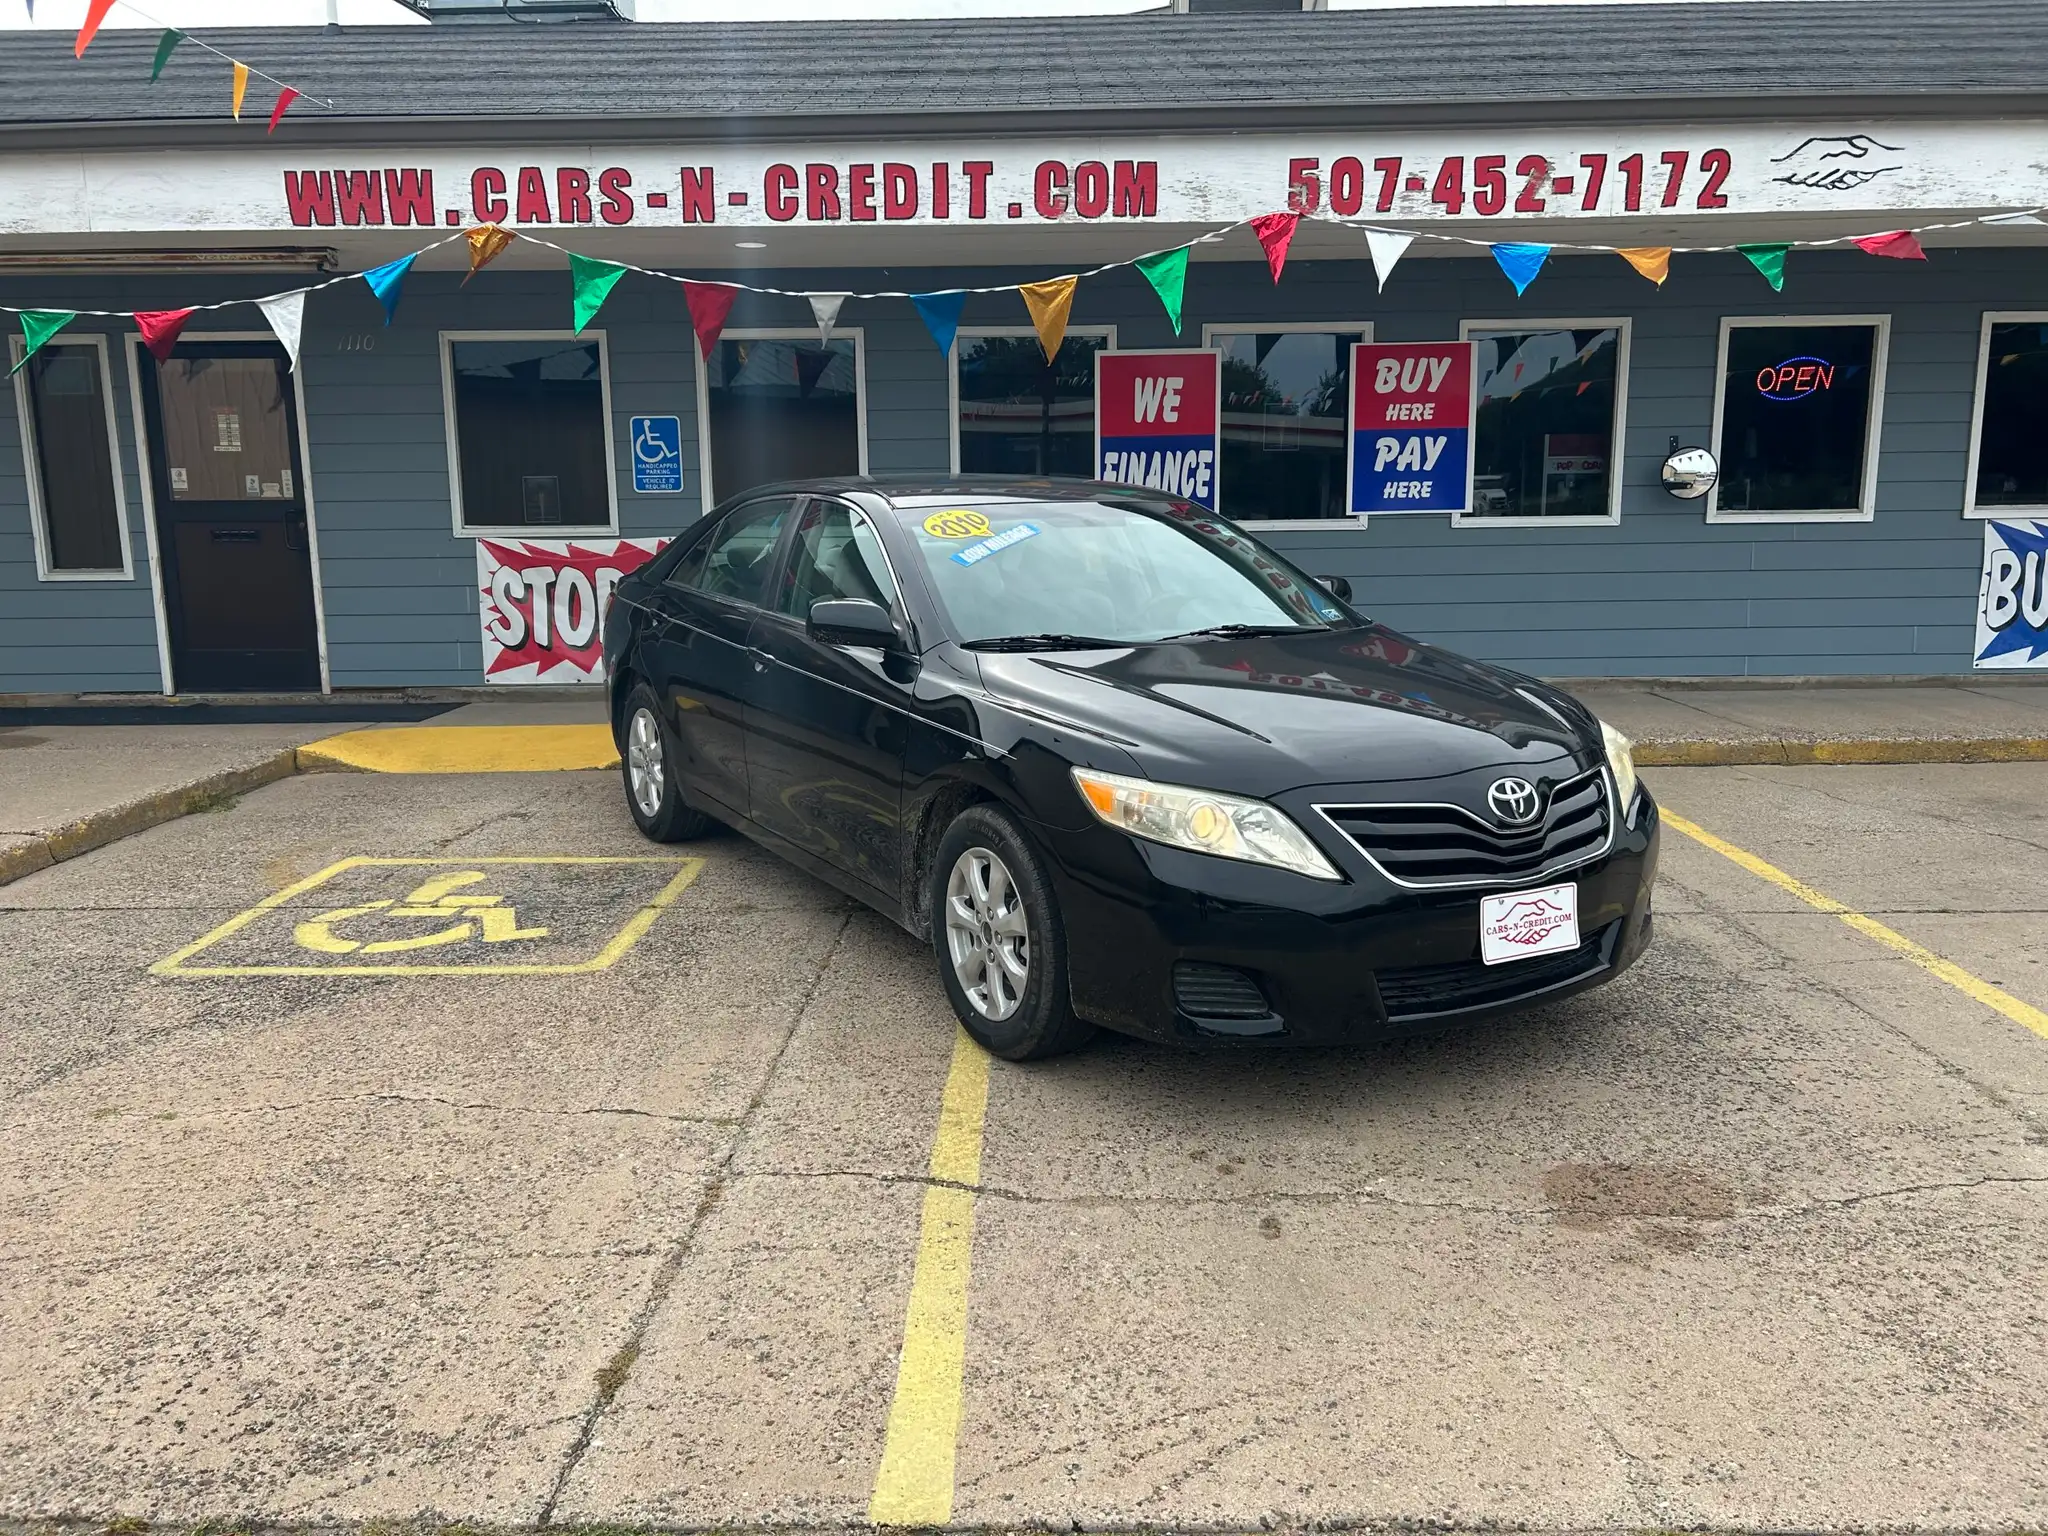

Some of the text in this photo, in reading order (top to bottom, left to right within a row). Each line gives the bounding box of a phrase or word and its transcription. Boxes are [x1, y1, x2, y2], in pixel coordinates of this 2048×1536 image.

[1288, 148, 1731, 217] 507-452-7172
[1374, 357, 1452, 394] BUY
[1757, 365, 1835, 392] OPEN
[1134, 377, 1184, 423] WE
[1385, 403, 1435, 422] HERE
[1374, 435, 1447, 472] PAY
[1103, 450, 1213, 498] FINANCE
[1383, 481, 1433, 499] HERE
[930, 513, 987, 537] 2010
[1486, 913, 1572, 936] CARS-N-CREDIT.COM
